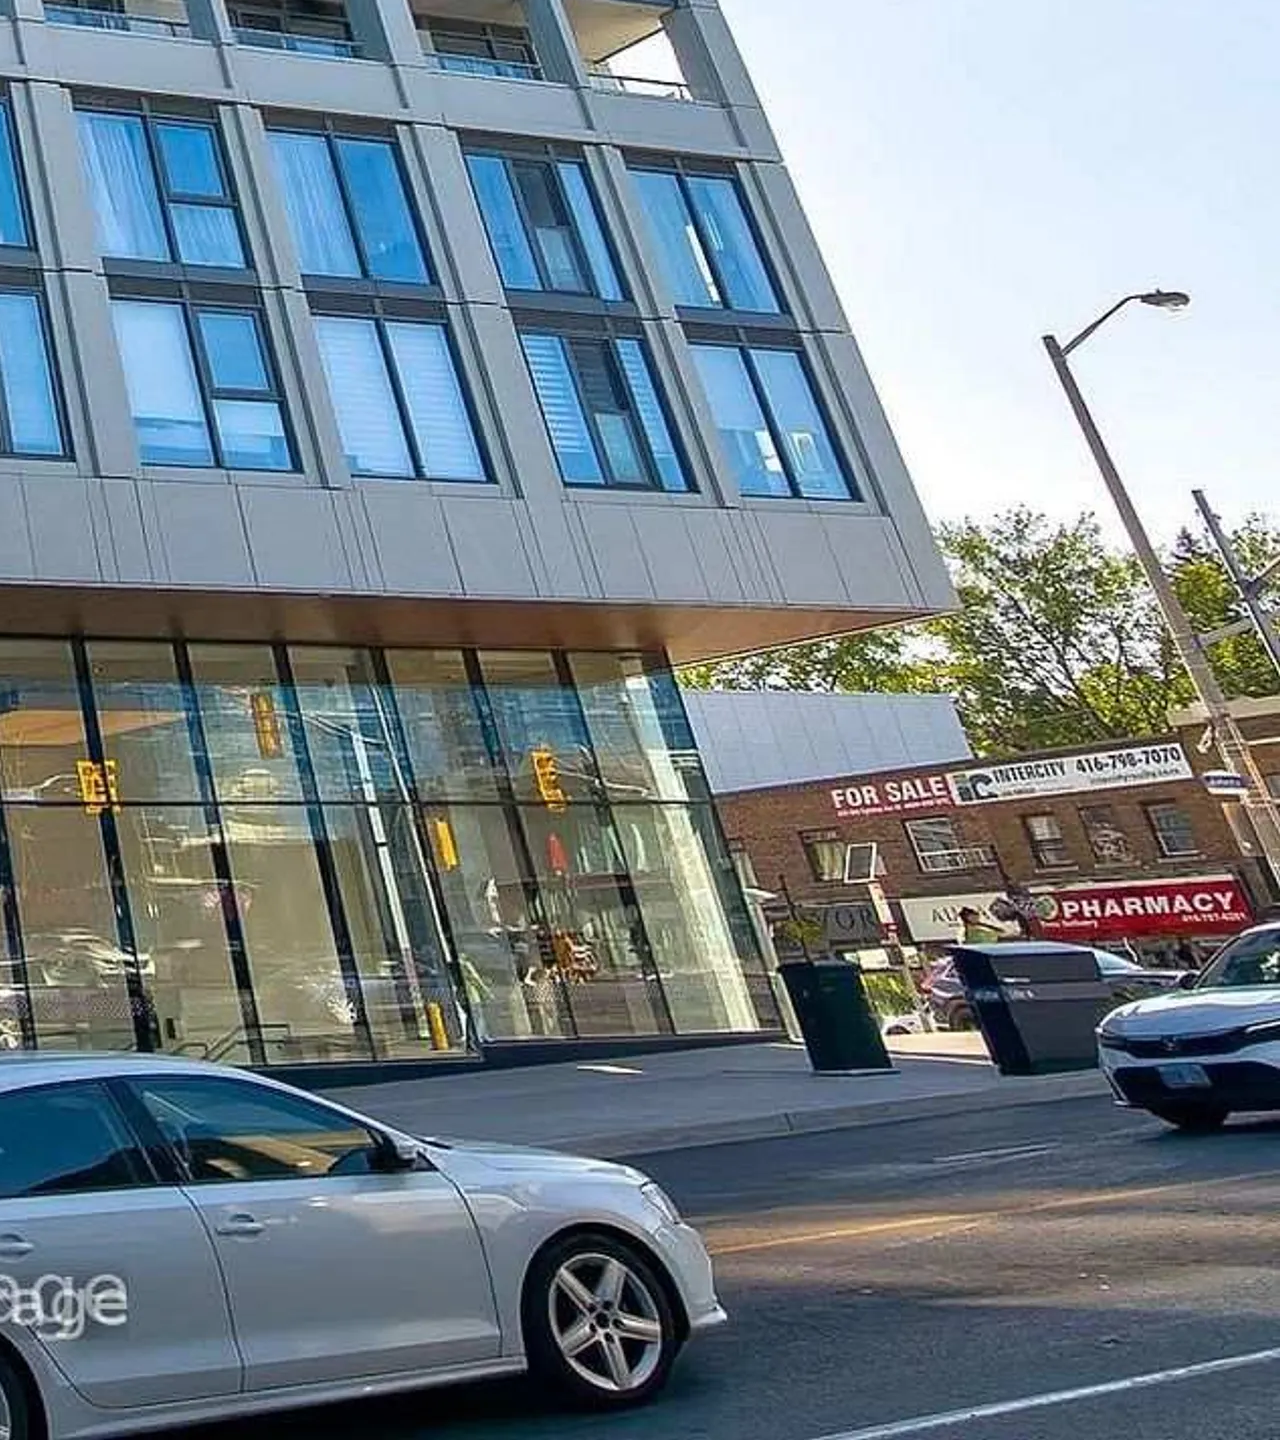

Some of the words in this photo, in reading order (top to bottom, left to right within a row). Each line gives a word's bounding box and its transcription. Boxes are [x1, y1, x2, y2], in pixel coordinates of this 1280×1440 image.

[992, 760, 1067, 784] INTERCITY
[1075, 746, 1181, 774] 416-798-7070
[831, 785, 879, 809] FOR
[887, 777, 947, 803] SALE
[1061, 891, 1234, 919] PHARMACY
